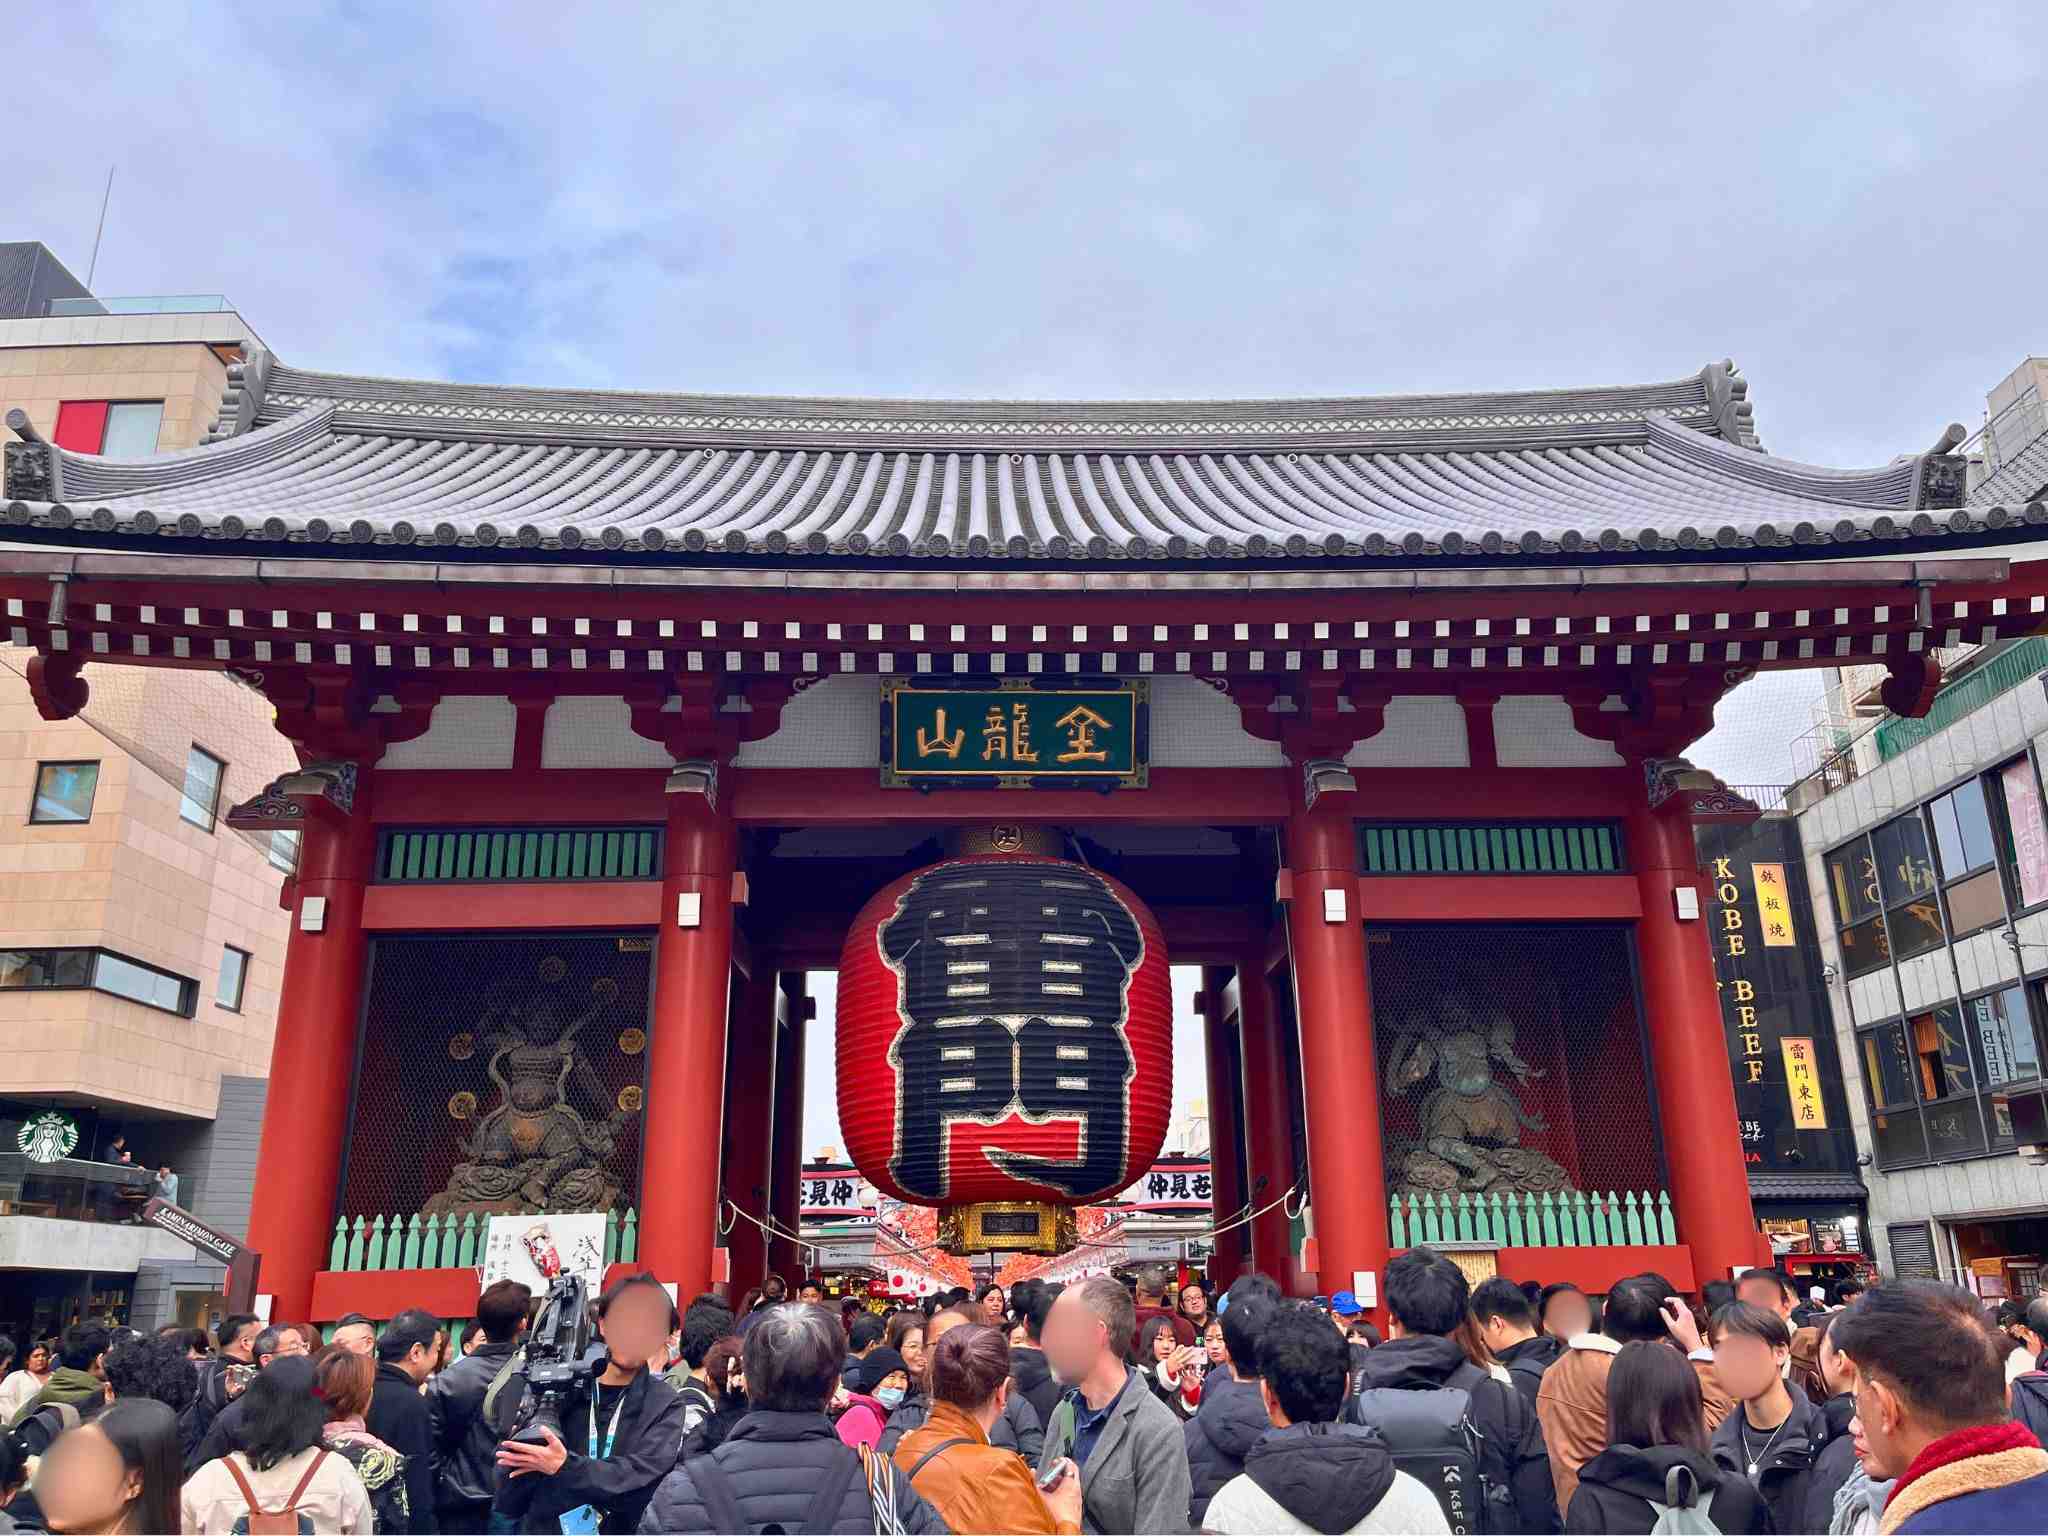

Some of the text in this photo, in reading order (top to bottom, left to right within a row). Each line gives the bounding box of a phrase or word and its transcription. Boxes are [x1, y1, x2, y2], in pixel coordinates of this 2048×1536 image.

[1760, 869, 1786, 937] 鉄板焼
[1713, 857, 1763, 1083] KOBE BEEF
[877, 862, 1145, 1198] 雷門
[1790, 1044, 1815, 1120] 雷門東店
[214, 1238, 237, 1255] GATE
